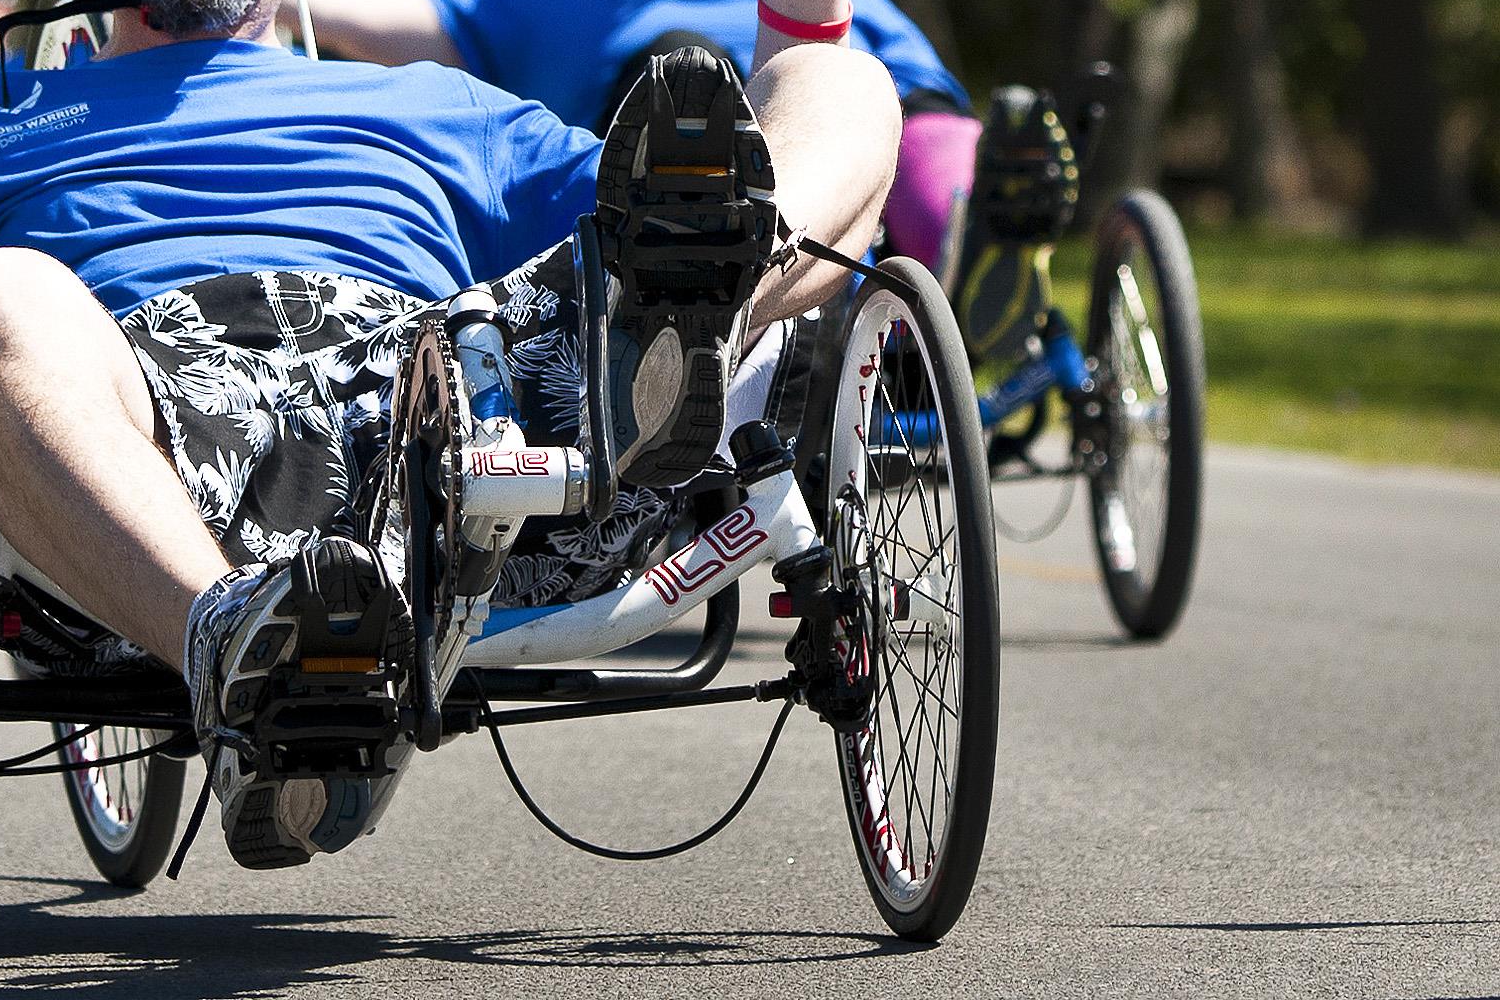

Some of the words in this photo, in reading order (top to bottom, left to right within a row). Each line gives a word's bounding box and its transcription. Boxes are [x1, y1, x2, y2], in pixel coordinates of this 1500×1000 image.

[25, 103, 90, 129] WARRIOR
[471, 450, 550, 477] ICE
[644, 504, 769, 605] ICE
